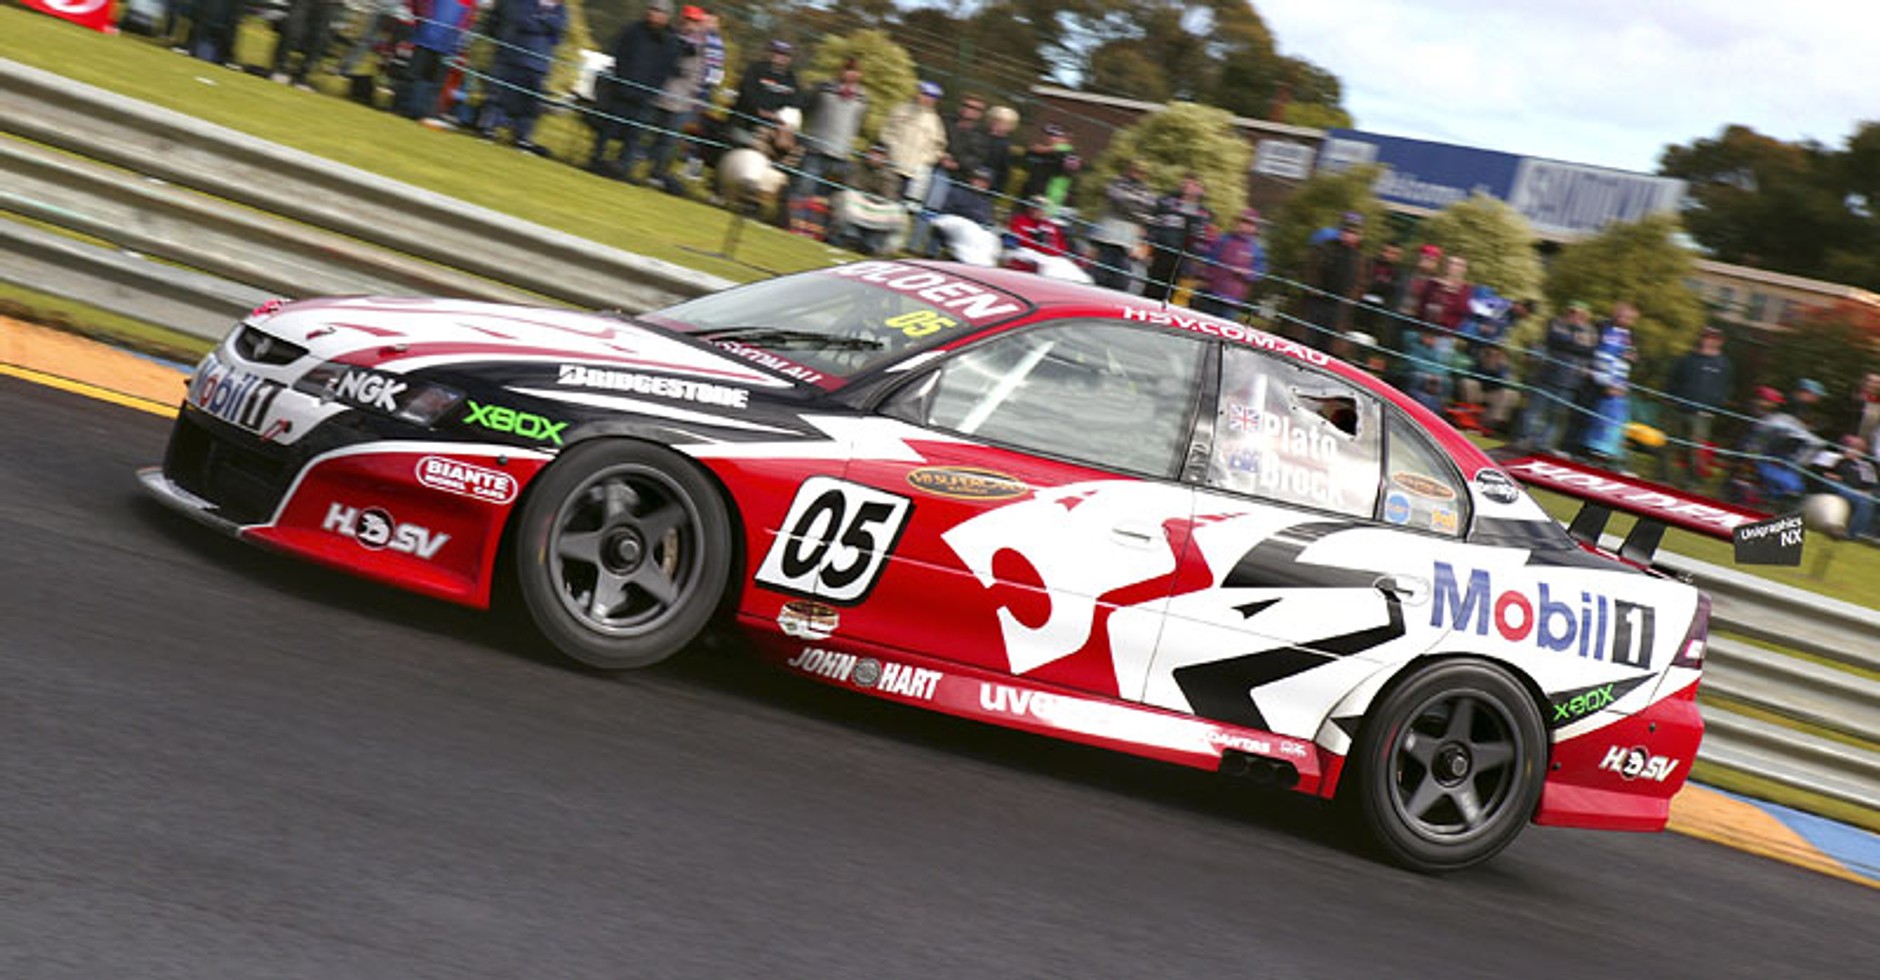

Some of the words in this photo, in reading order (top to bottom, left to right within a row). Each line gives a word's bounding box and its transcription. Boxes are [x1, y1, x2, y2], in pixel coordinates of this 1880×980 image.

[885, 310, 957, 337] 05
[335, 371, 407, 411] NGK
[557, 365, 749, 408] BRIDGESTONE
[463, 400, 568, 445] XBOX
[1264, 410, 1337, 458] Plato
[426, 460, 509, 492] BIANTE
[782, 489, 896, 589] 05
[1780, 528, 1803, 547] NX
[1430, 560, 1607, 661] Mobil
[788, 647, 856, 681] JOHN
[877, 662, 944, 701] HART
